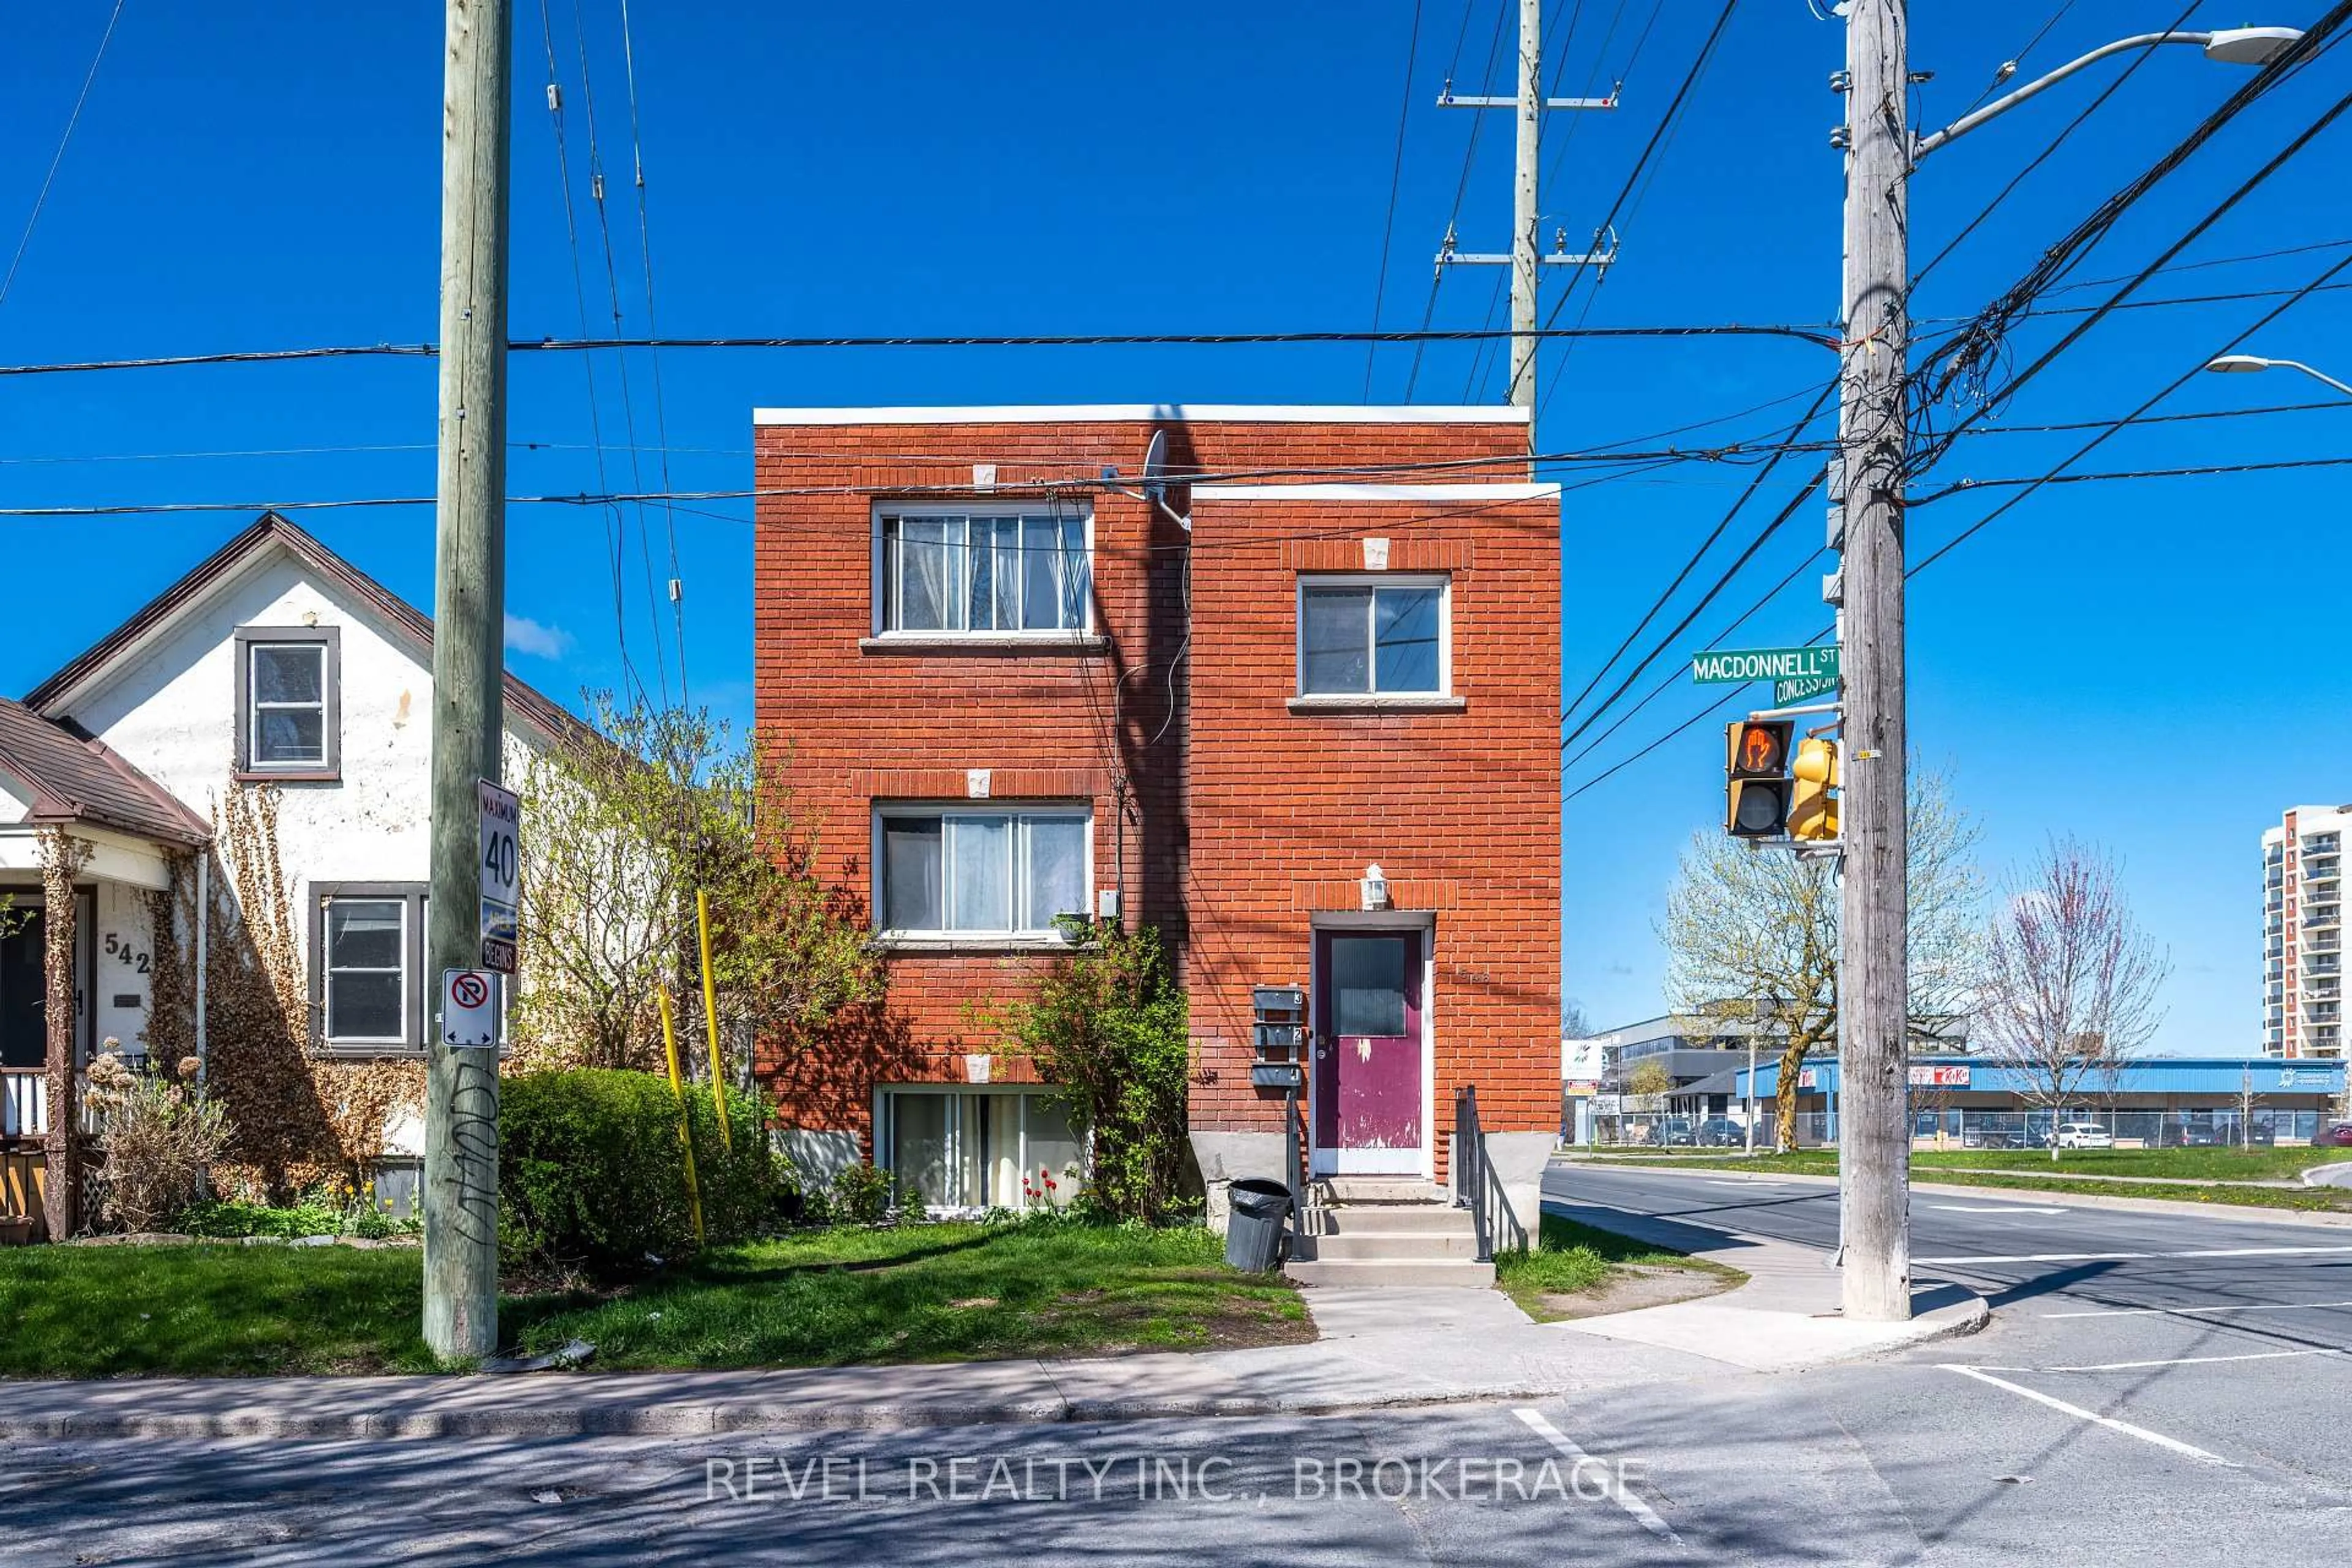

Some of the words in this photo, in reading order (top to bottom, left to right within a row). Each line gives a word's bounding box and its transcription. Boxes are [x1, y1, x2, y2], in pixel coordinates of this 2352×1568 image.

[1694, 653, 1822, 680] MACDONNELL
[1820, 649, 1836, 663] ST
[483, 794, 516, 824] MAXIMUM
[485, 831, 514, 888] 40
[105, 933, 151, 974] 542
[484, 941, 513, 970] BEGINS
[1294, 1028, 1302, 1039] 2
